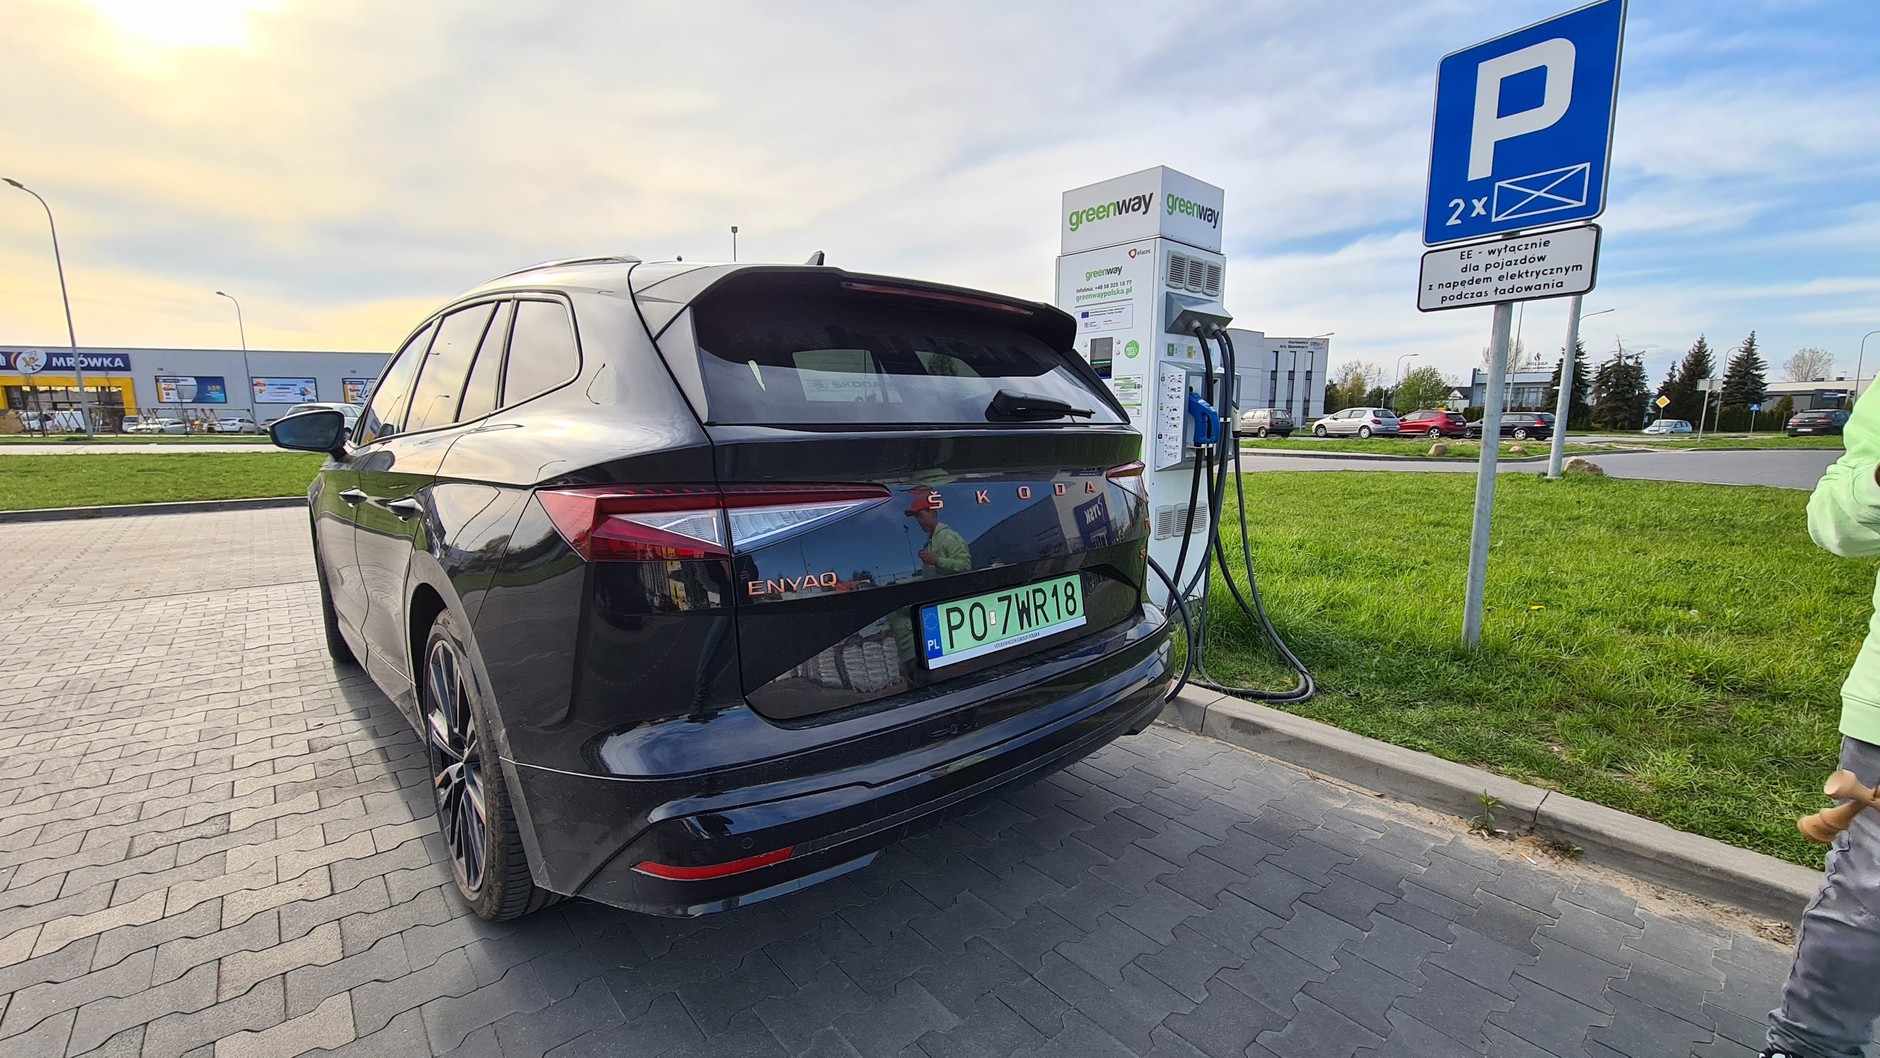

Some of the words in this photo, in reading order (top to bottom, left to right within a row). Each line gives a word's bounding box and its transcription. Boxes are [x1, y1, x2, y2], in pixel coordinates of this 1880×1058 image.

[1468, 37, 1576, 182] P
[1069, 192, 1154, 231] greenway
[1166, 192, 1220, 229] greenway
[1446, 198, 1466, 226] 2
[1460, 250, 1473, 261] EE
[1488, 239, 1551, 257] wyłącznie
[1086, 266, 1123, 281] greenway
[1461, 263, 1479, 273] dla
[1485, 253, 1547, 272] pojazdów
[1438, 276, 1492, 290] napędem
[1498, 263, 1583, 282] elektrycznym
[1076, 287, 1133, 303] greenwaypolska.pl
[1441, 290, 1489, 304] podczas
[1494, 280, 1564, 296] ładowania
[52, 355, 124, 367] MRÓWKA
[928, 481, 1095, 509] ŠKODA
[748, 572, 837, 596] ENYAQ
[945, 602, 988, 649] PO
[998, 581, 1077, 635] 7WR18
[927, 638, 940, 651] PL
